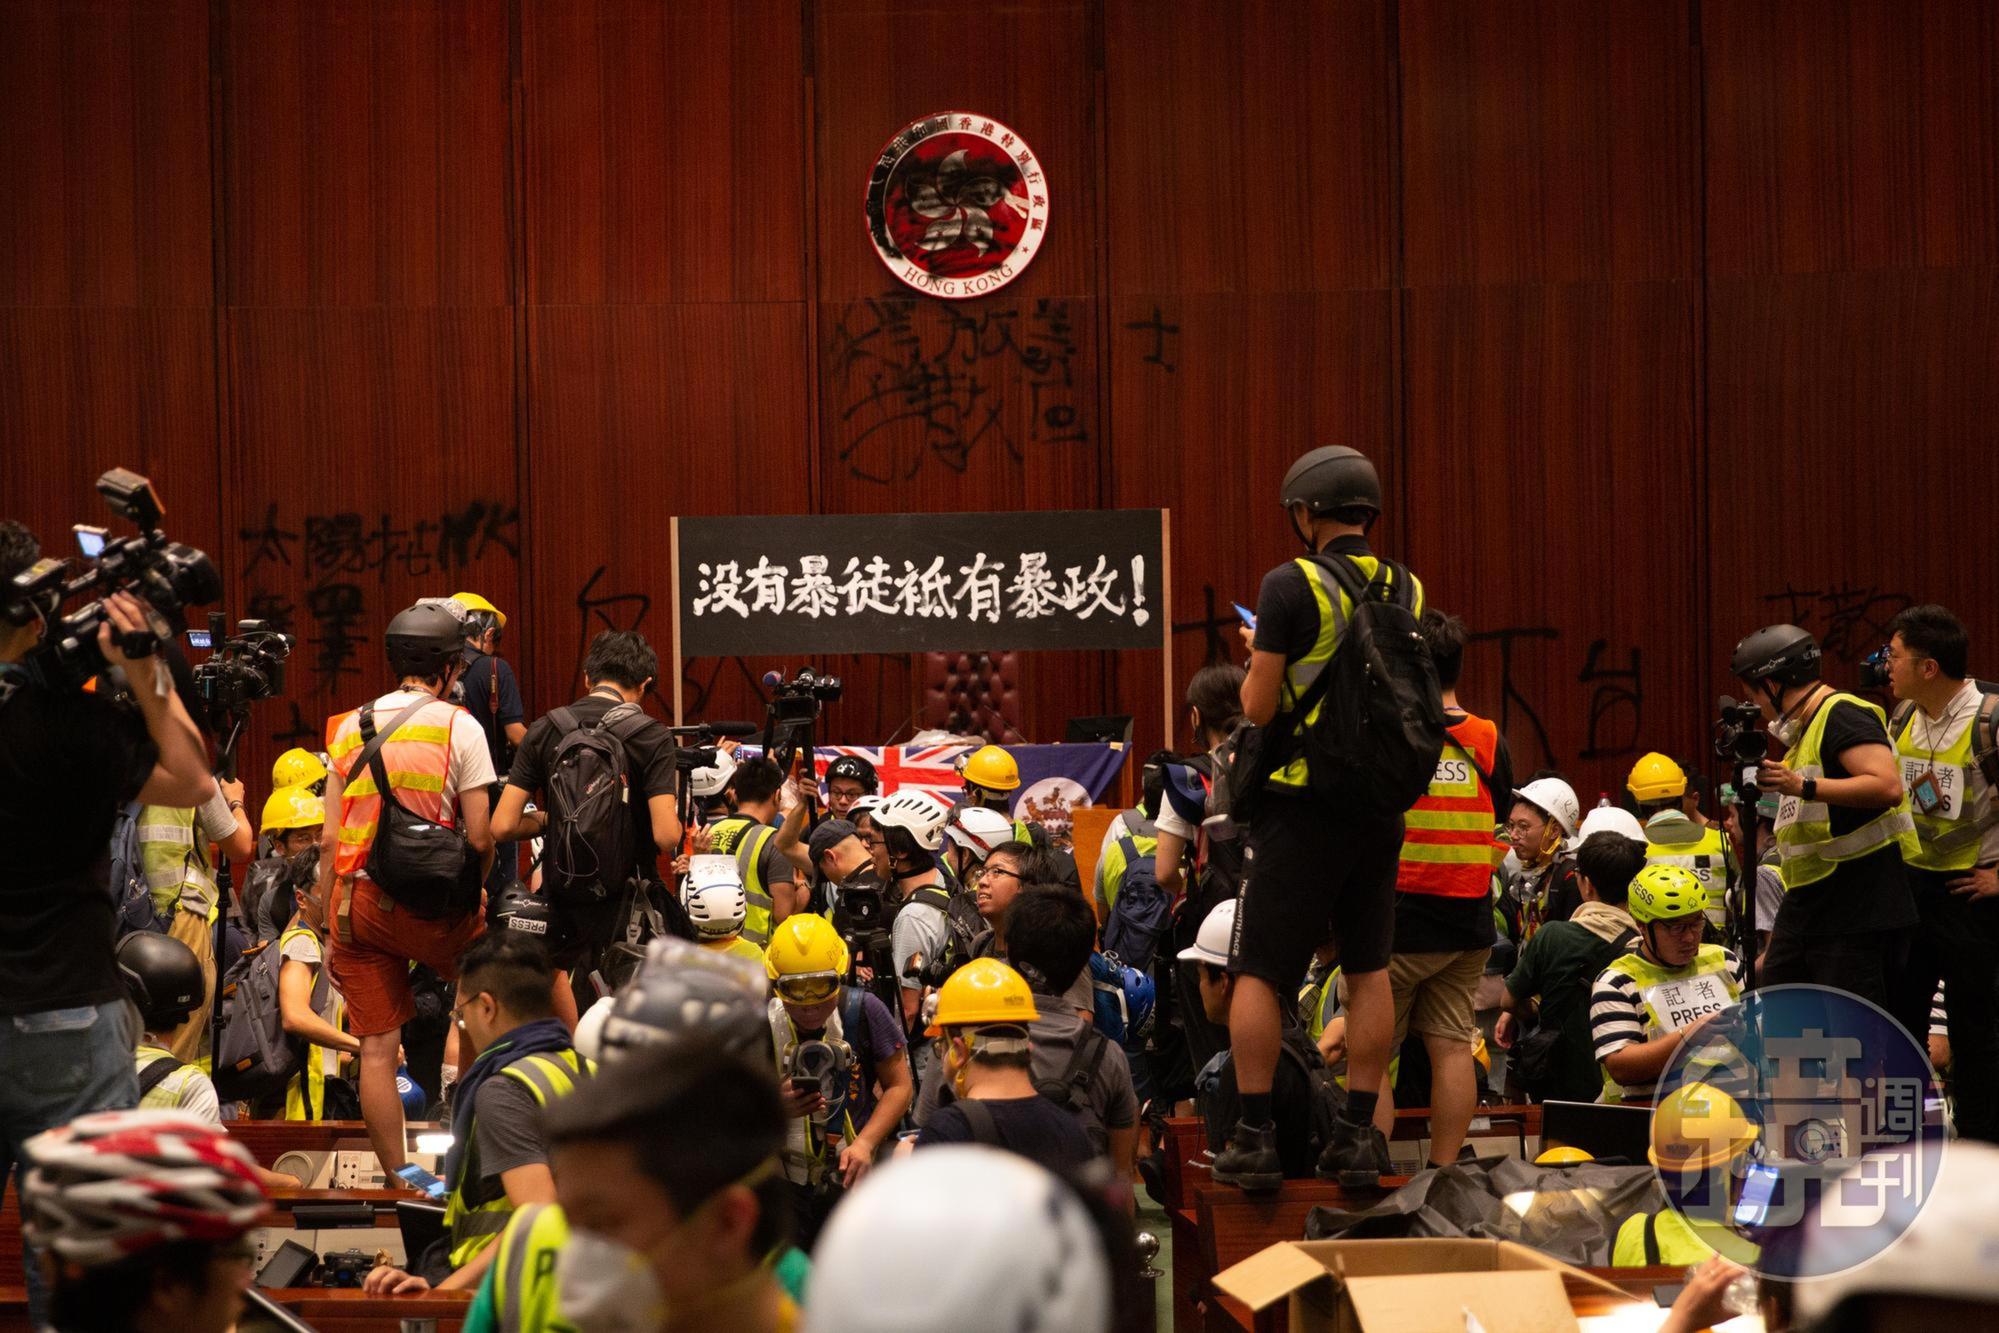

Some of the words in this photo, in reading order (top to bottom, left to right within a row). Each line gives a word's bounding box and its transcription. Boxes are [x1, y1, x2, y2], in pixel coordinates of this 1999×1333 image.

[903, 266, 955, 295] HONG
[963, 263, 1014, 295] KONG
[1434, 761, 1466, 782] ESS
[1240, 879, 1248, 897] THE
[1631, 879, 1654, 906] RESS
[511, 918, 546, 932] PRESS
[1236, 898, 1244, 931] NORTH
[1232, 931, 1241, 957] FACE
[1661, 980, 1716, 1007] 記者
